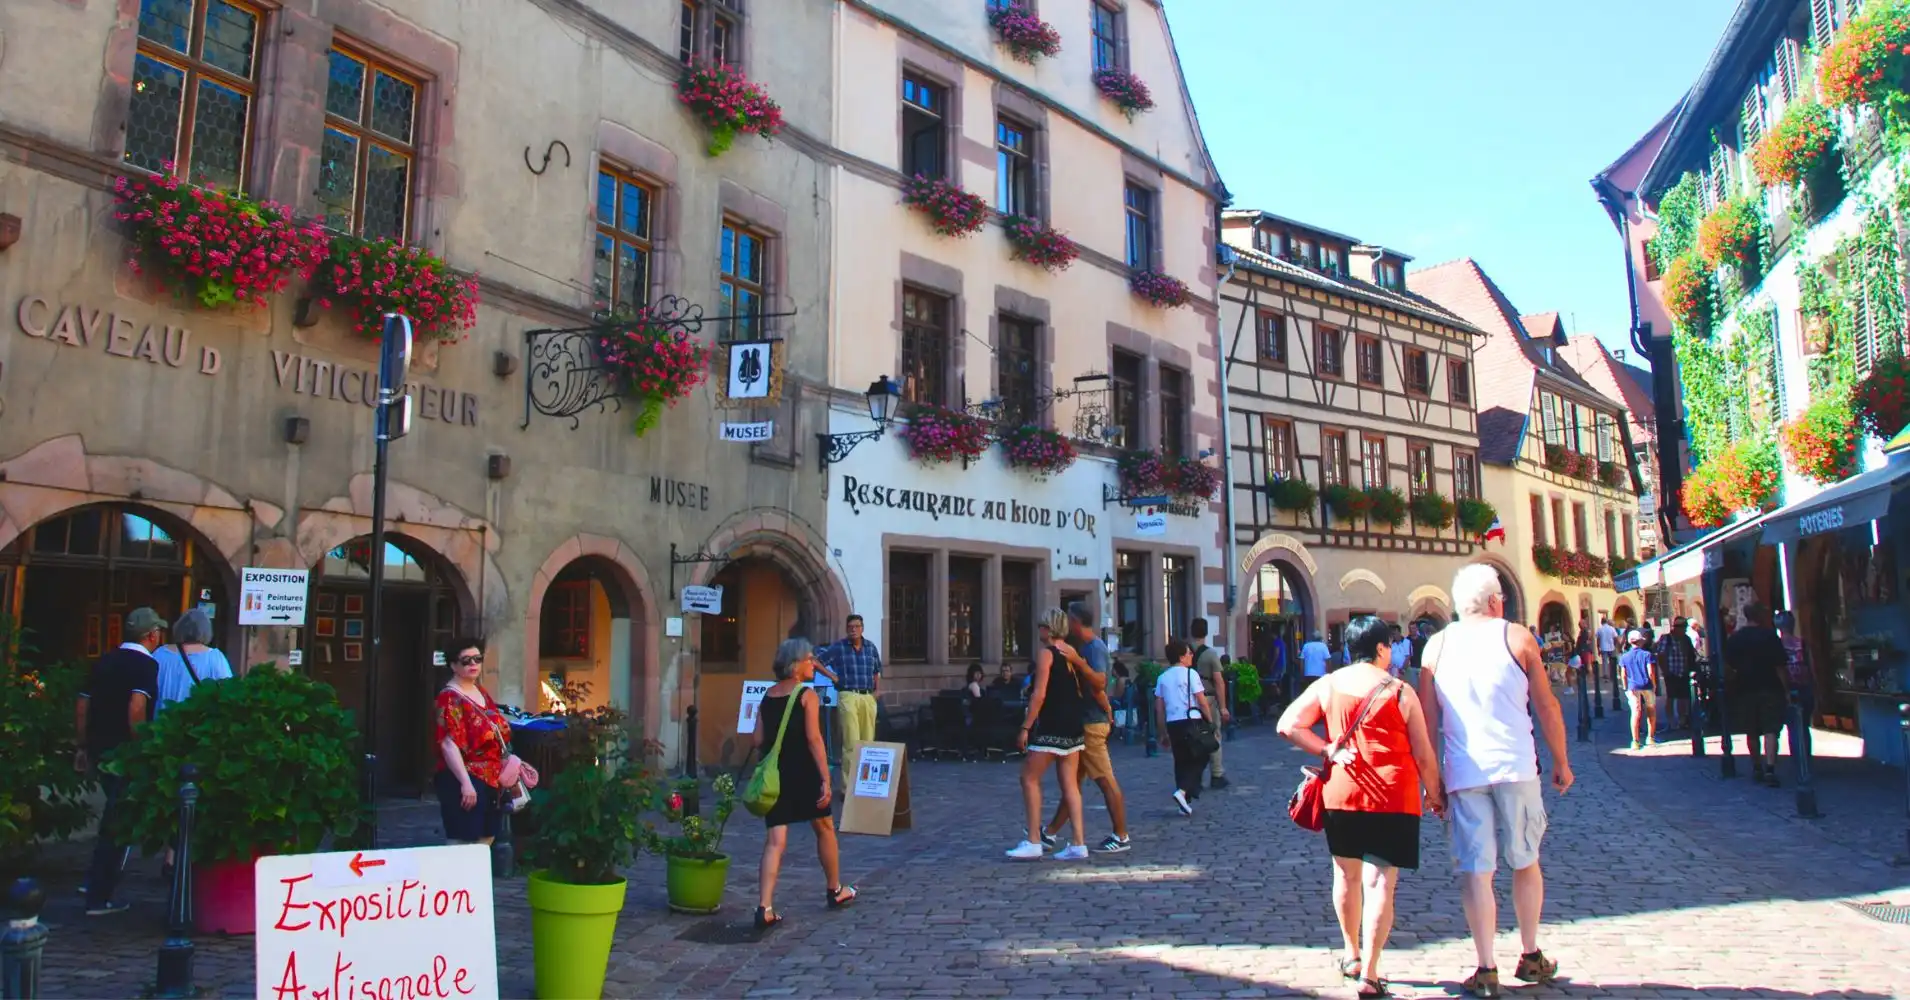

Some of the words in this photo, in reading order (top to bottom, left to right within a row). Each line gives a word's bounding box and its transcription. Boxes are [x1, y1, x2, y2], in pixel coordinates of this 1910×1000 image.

[18, 295, 191, 367] CAVEAU
[271, 350, 479, 427] VITICUTEUR
[725, 426, 768, 438] MUSEE
[650, 475, 709, 511] MUSEE
[843, 475, 976, 521] RESTAURANT
[1800, 506, 1844, 535] POTERIES
[245, 573, 305, 583] EXPOSITION
[267, 593, 304, 602] Peintures
[267, 603, 302, 612] Sculptures
[746, 686, 767, 694] EXP
[274, 874, 475, 937] Exposition
[272, 951, 476, 1000] Artisanale
